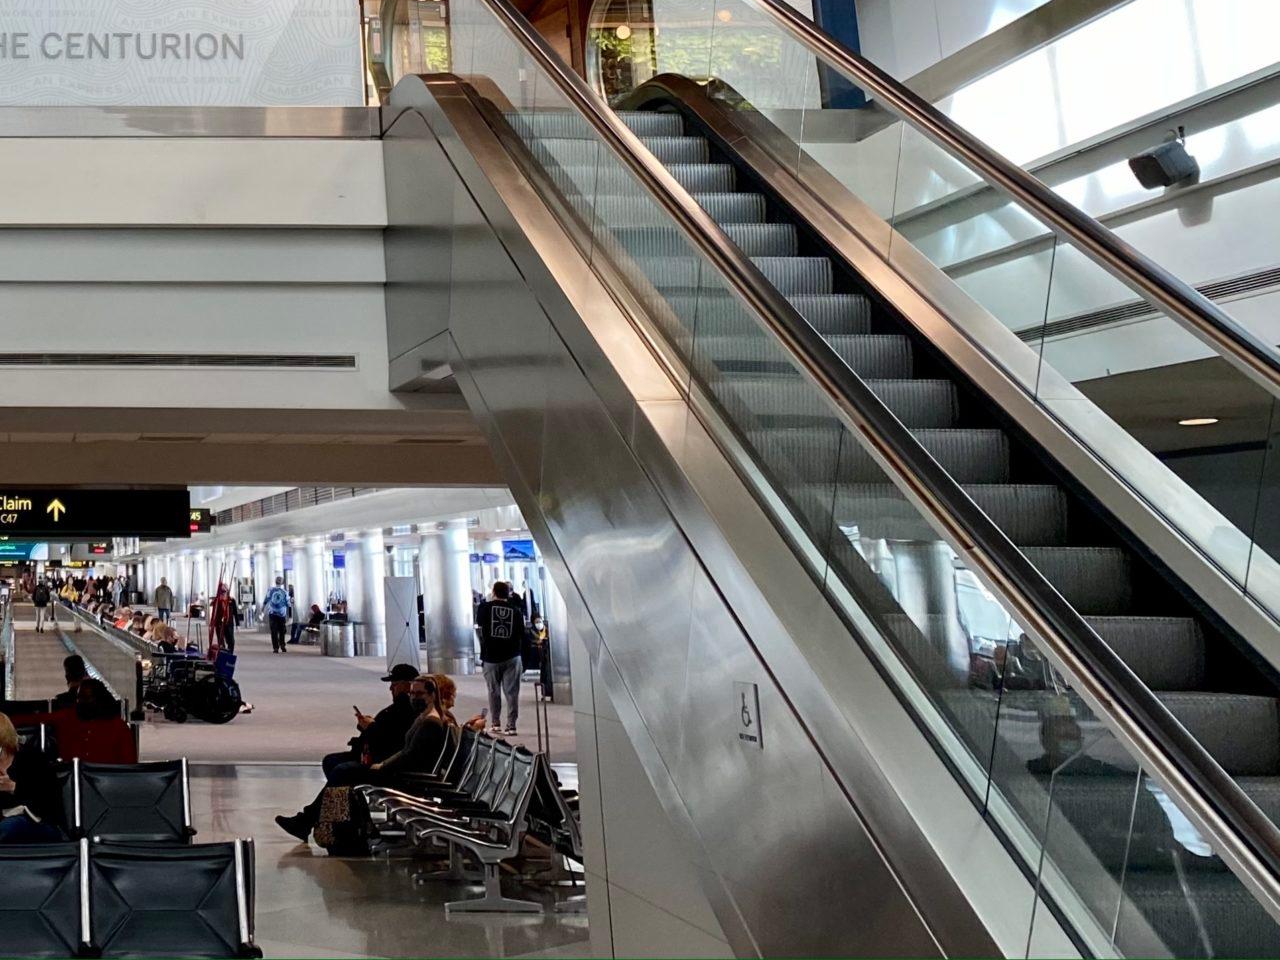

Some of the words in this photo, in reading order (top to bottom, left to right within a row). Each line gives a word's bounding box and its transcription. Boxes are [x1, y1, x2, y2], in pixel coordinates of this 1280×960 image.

[40, 31, 245, 60] CENTURION
[0, 513, 18, 524] C47
[190, 511, 202, 521] 45
